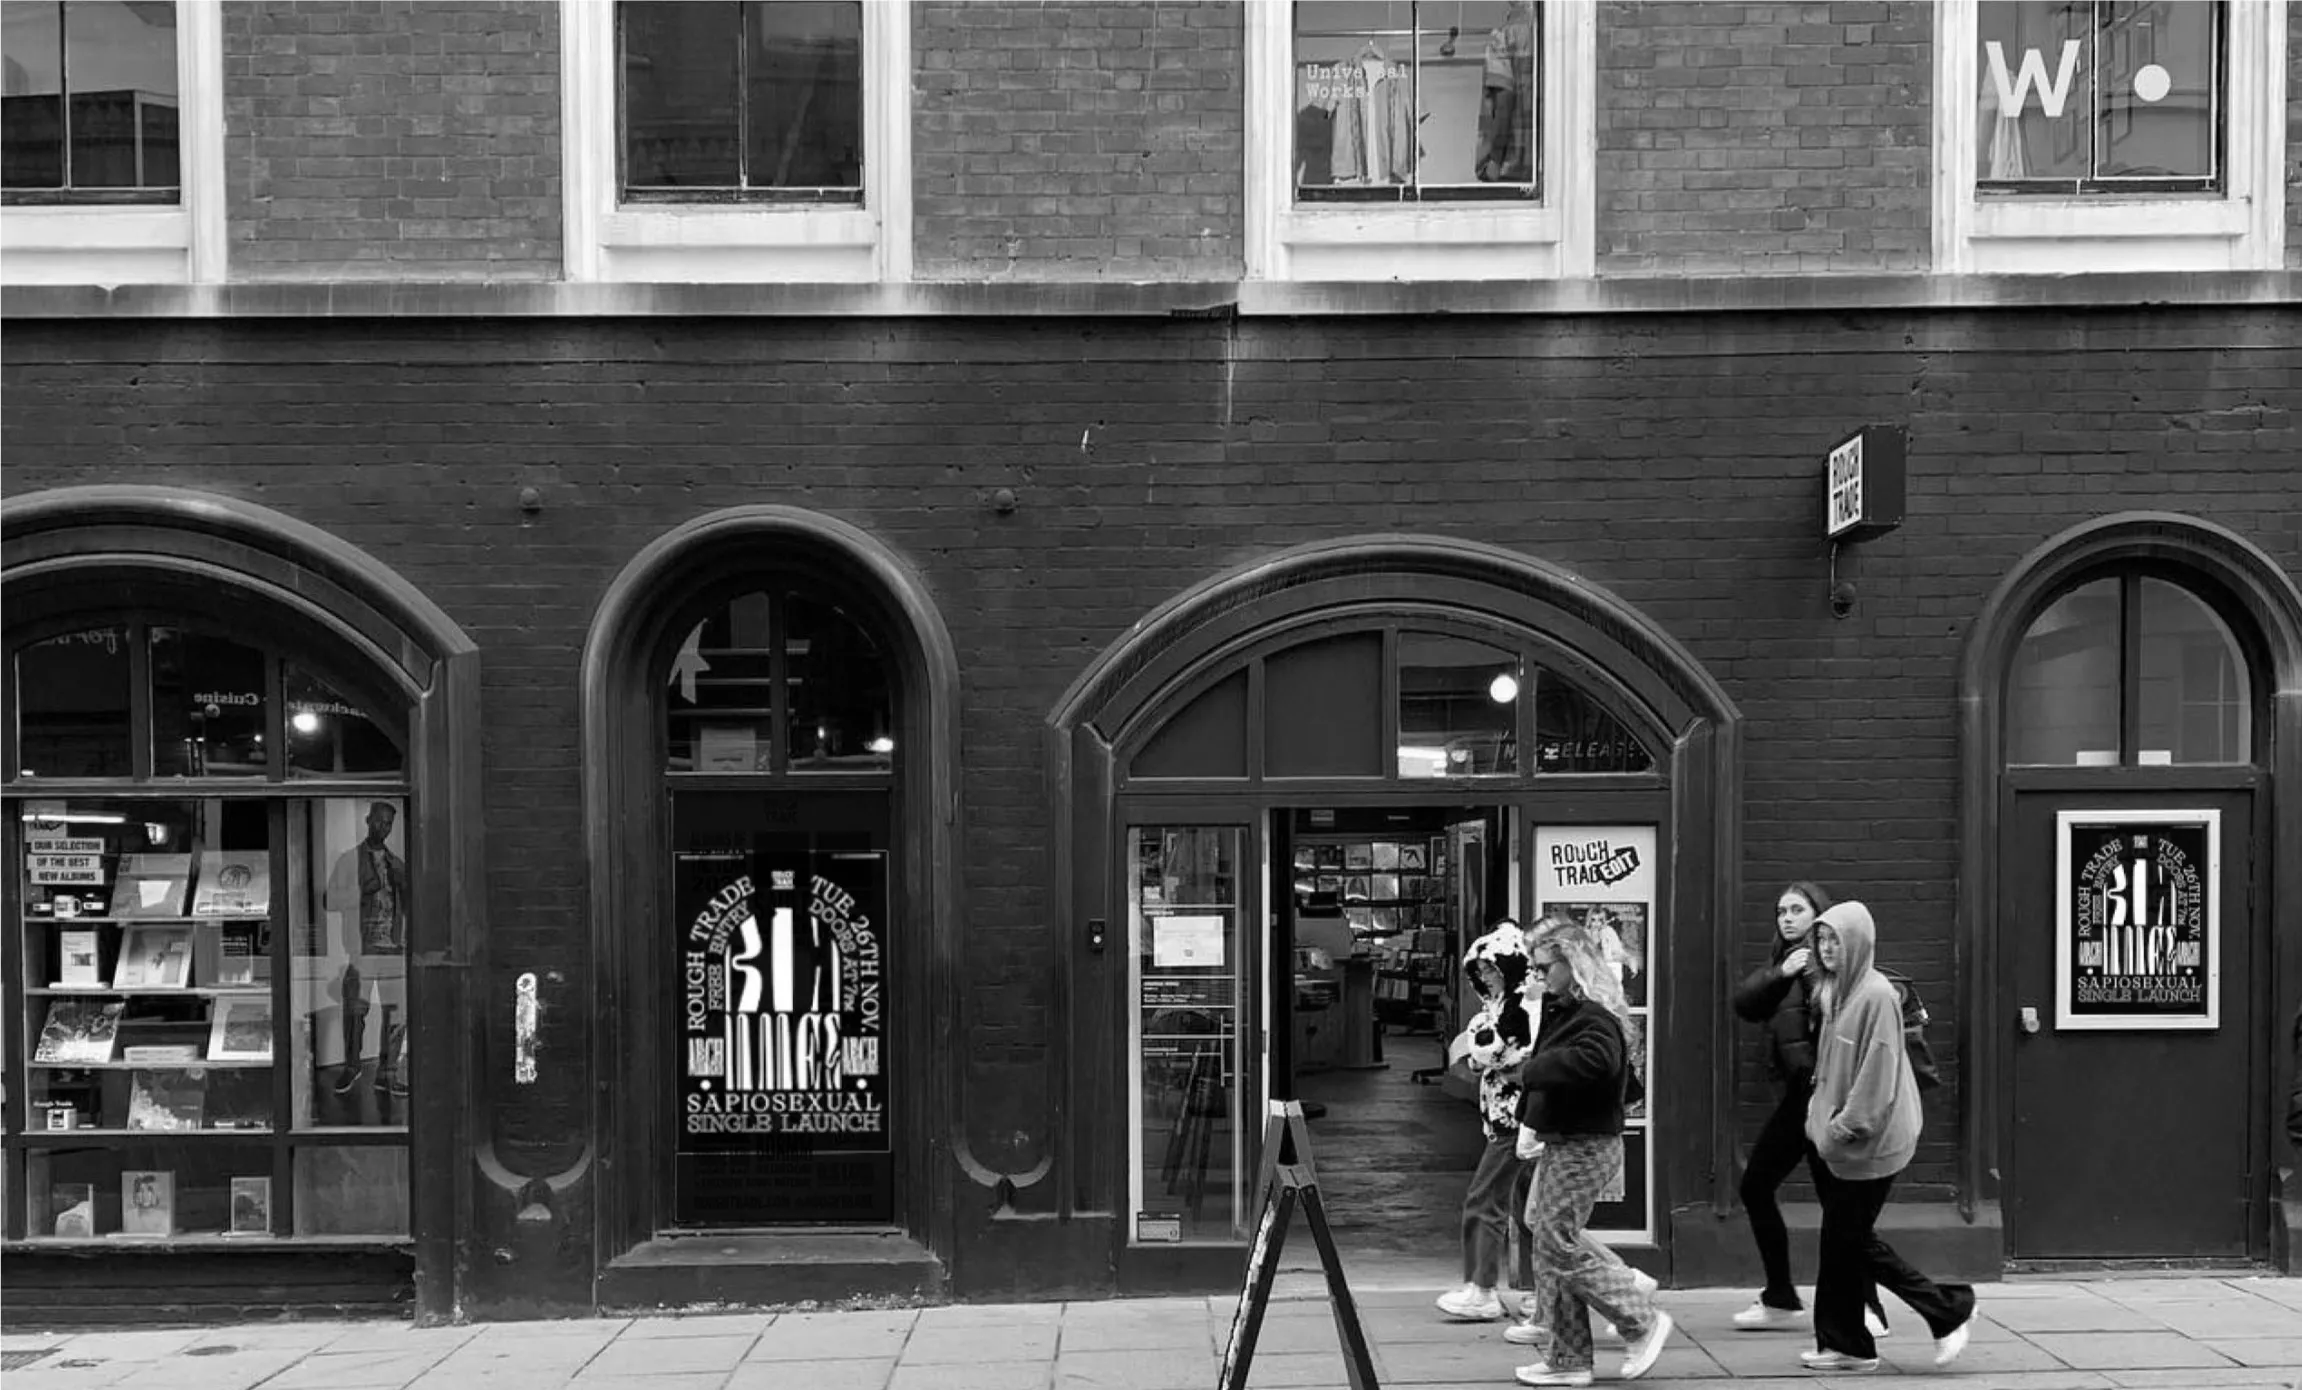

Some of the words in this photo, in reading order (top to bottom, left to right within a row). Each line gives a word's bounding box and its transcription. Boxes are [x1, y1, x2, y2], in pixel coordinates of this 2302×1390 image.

[1307, 64, 1408, 80] Univesal
[1985, 39, 2081, 118] W
[1551, 840, 1609, 864] ROUGH
[2081, 838, 2123, 880] TRADE
[2158, 838, 2187, 866] TUE
[1554, 864, 1602, 886] TRAD
[690, 875, 756, 942] TRADE
[2078, 886, 2091, 937] ROUGH
[810, 875, 856, 919] TUE
[850, 915, 879, 977] 26TH
[843, 956, 858, 983] AT
[2078, 976, 2202, 989] SAPIOSEXUAL
[686, 951, 706, 1031] ROUGH
[2138, 989, 2200, 1002] LAUNCH
[687, 1092, 881, 1113] SAPIOSEXUAL
[687, 1113, 772, 1133] SINGLE
[780, 1113, 881, 1132] LAUNCH
